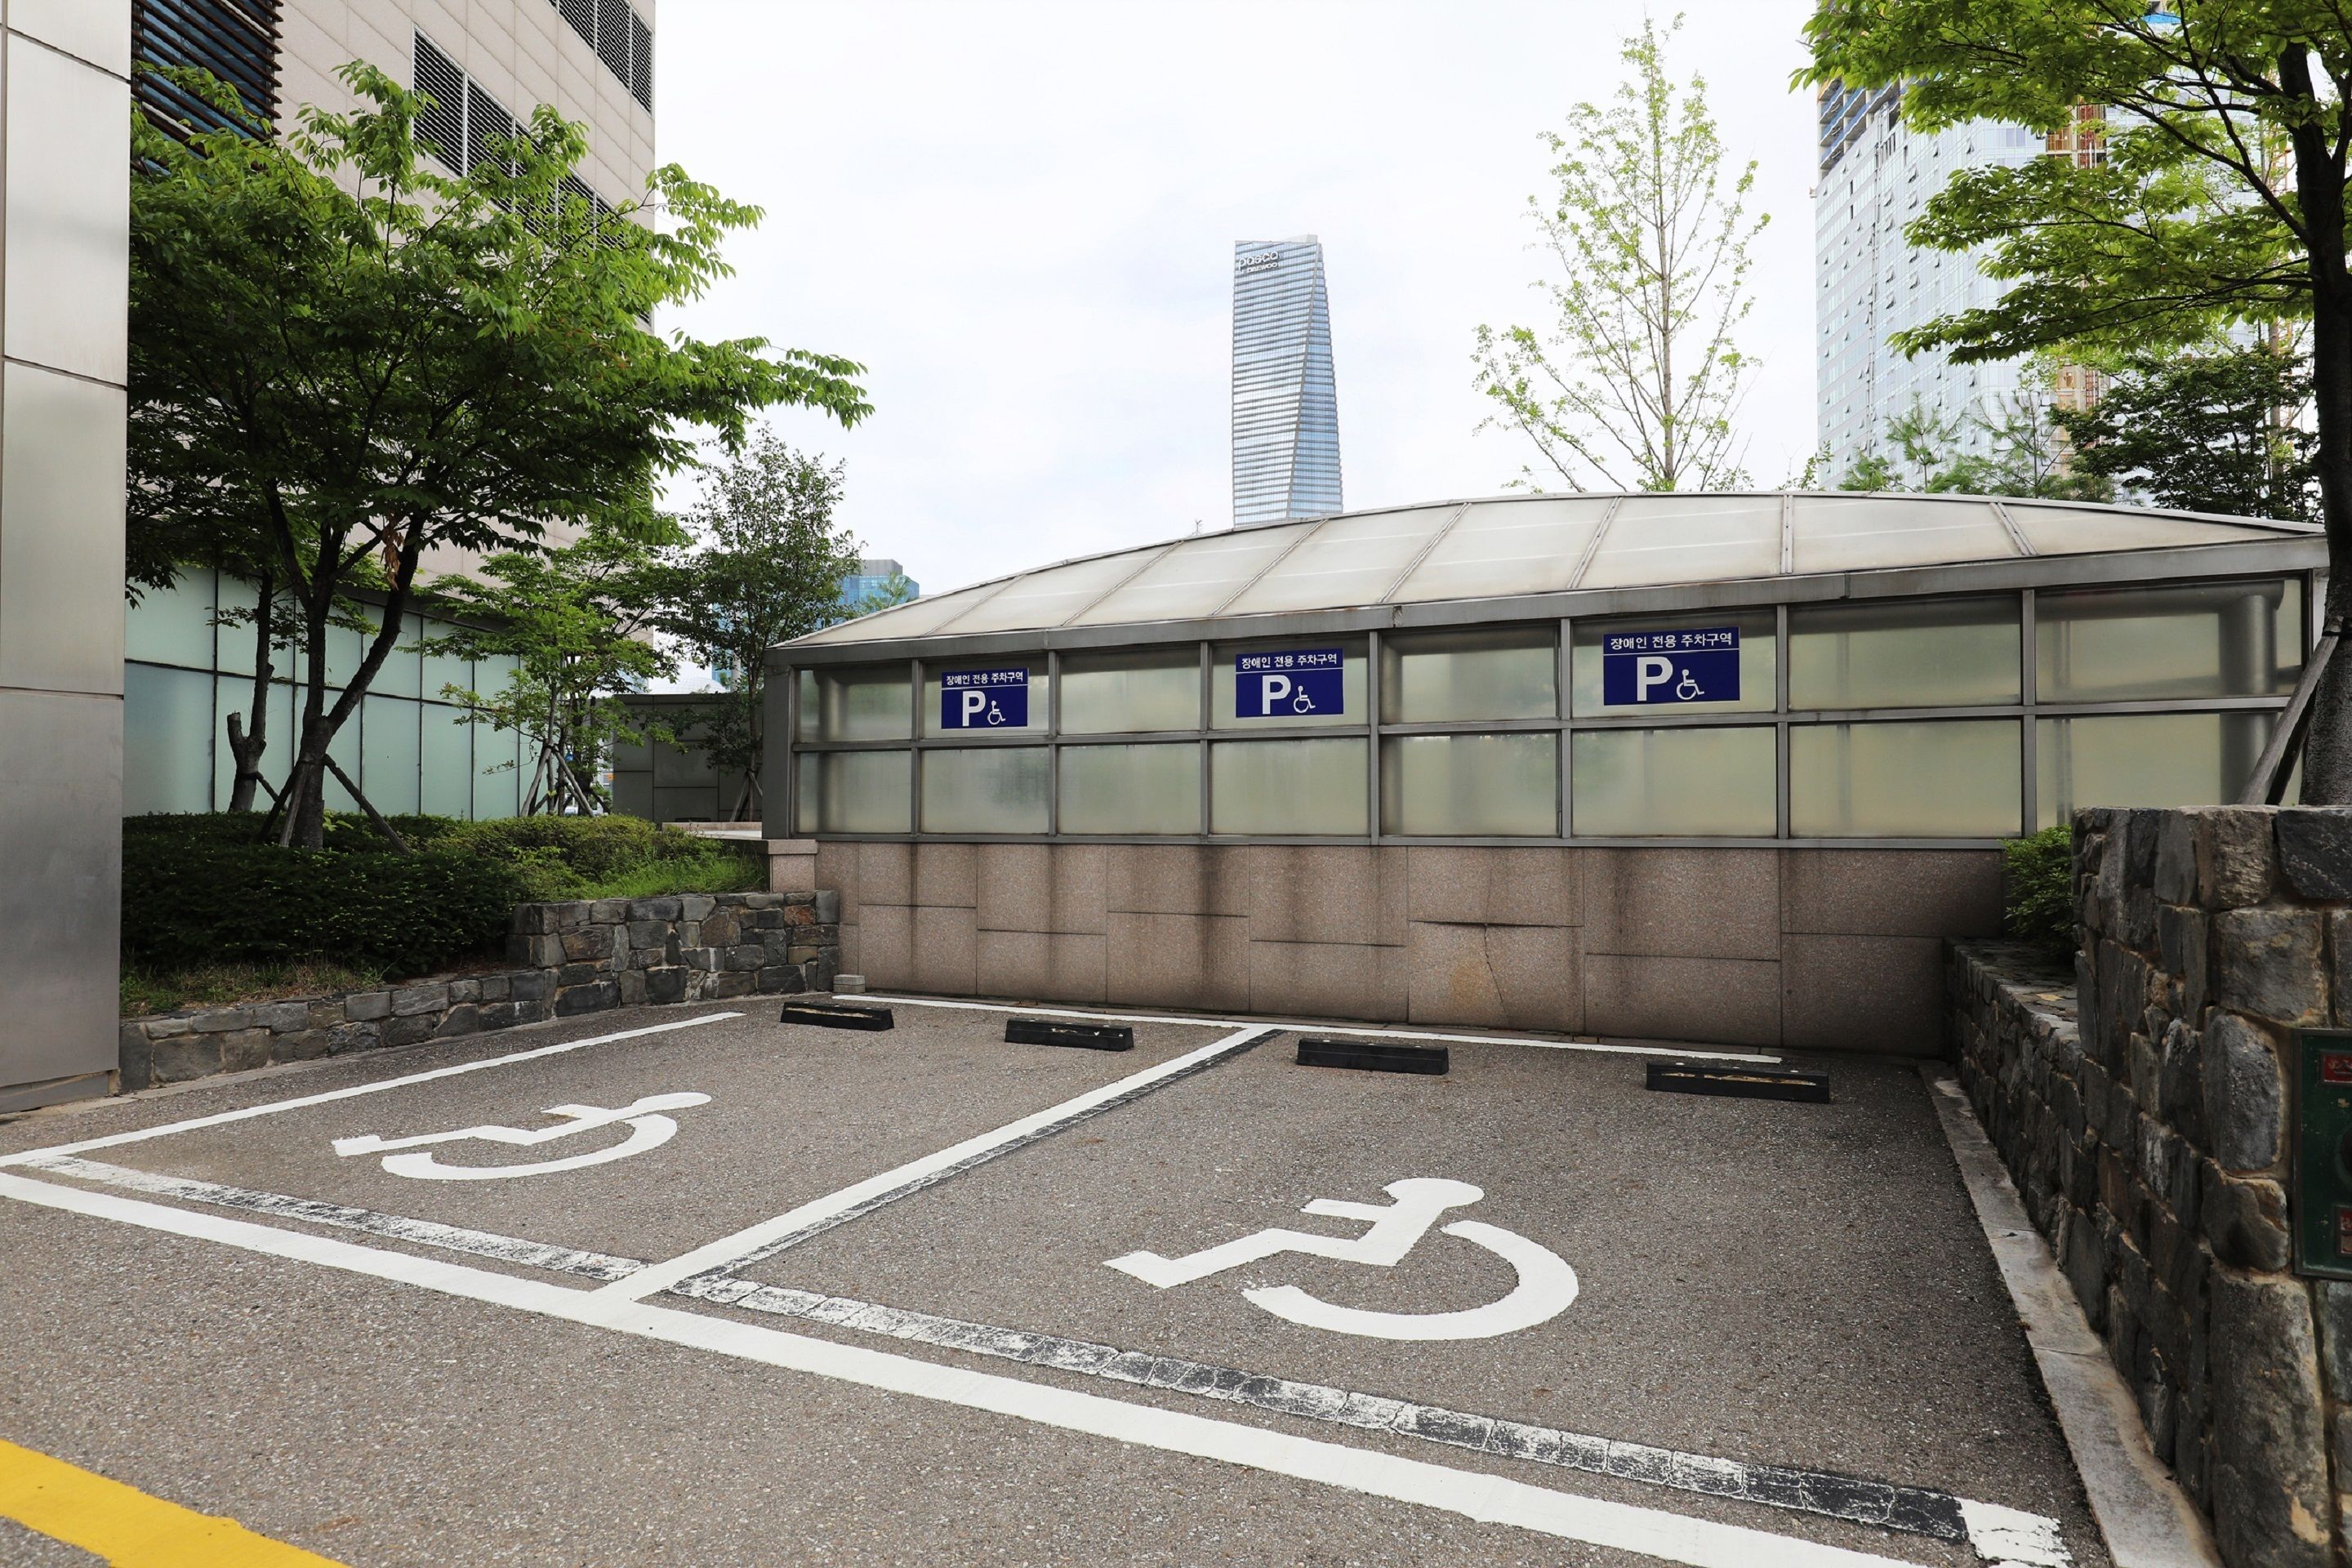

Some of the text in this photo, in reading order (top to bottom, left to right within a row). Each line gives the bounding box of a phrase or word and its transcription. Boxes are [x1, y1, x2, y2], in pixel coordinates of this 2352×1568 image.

[1610, 632, 1732, 650] 장애인 전용 주차구역
[1241, 653, 1337, 669] 장애인 전용 주차구역
[947, 671, 1023, 685] 장애인 전용 주차구역
[1637, 656, 1673, 702] P
[962, 690, 986, 727] P
[1262, 675, 1291, 715] P
